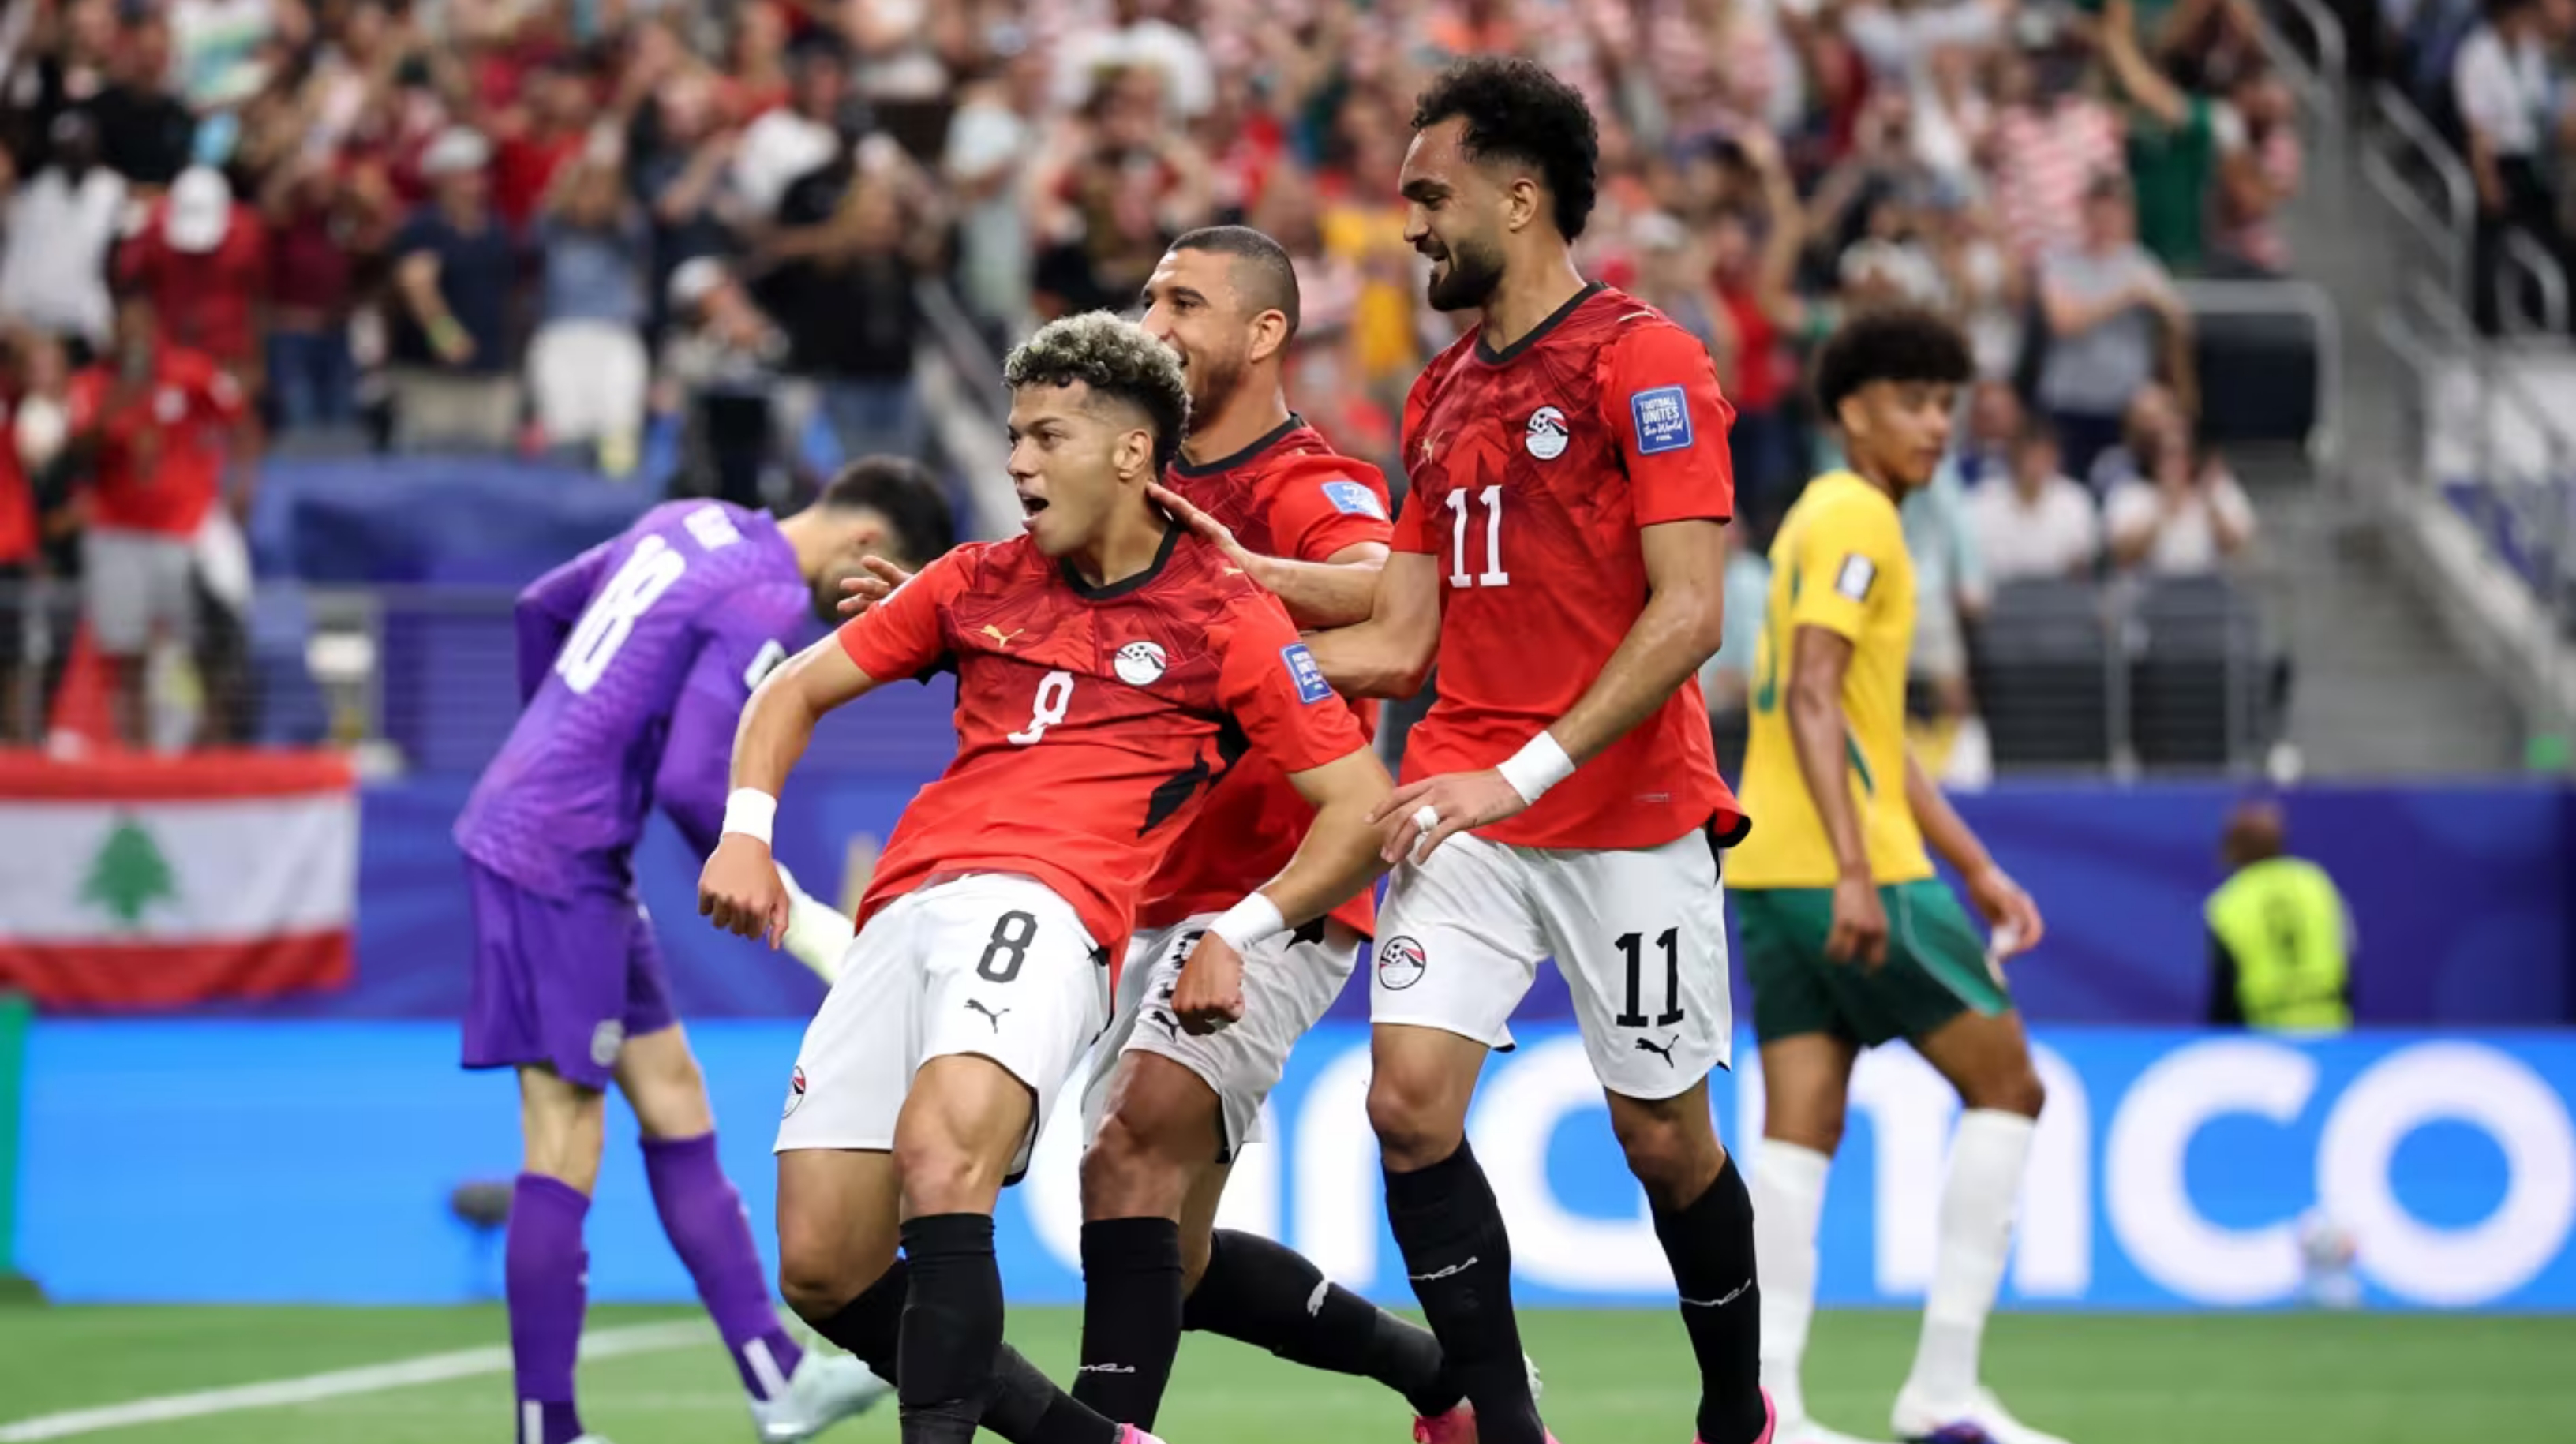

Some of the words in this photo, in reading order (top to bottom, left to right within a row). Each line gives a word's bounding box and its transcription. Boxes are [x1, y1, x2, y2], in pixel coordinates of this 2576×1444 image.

[1642, 406, 1679, 425] UNITES
[1445, 484, 1510, 588] 11
[555, 534, 686, 694] 18
[975, 909, 1039, 984] 8
[1614, 926, 1685, 1028] 11
[1023, 1038, 2576, 1305] ramco
